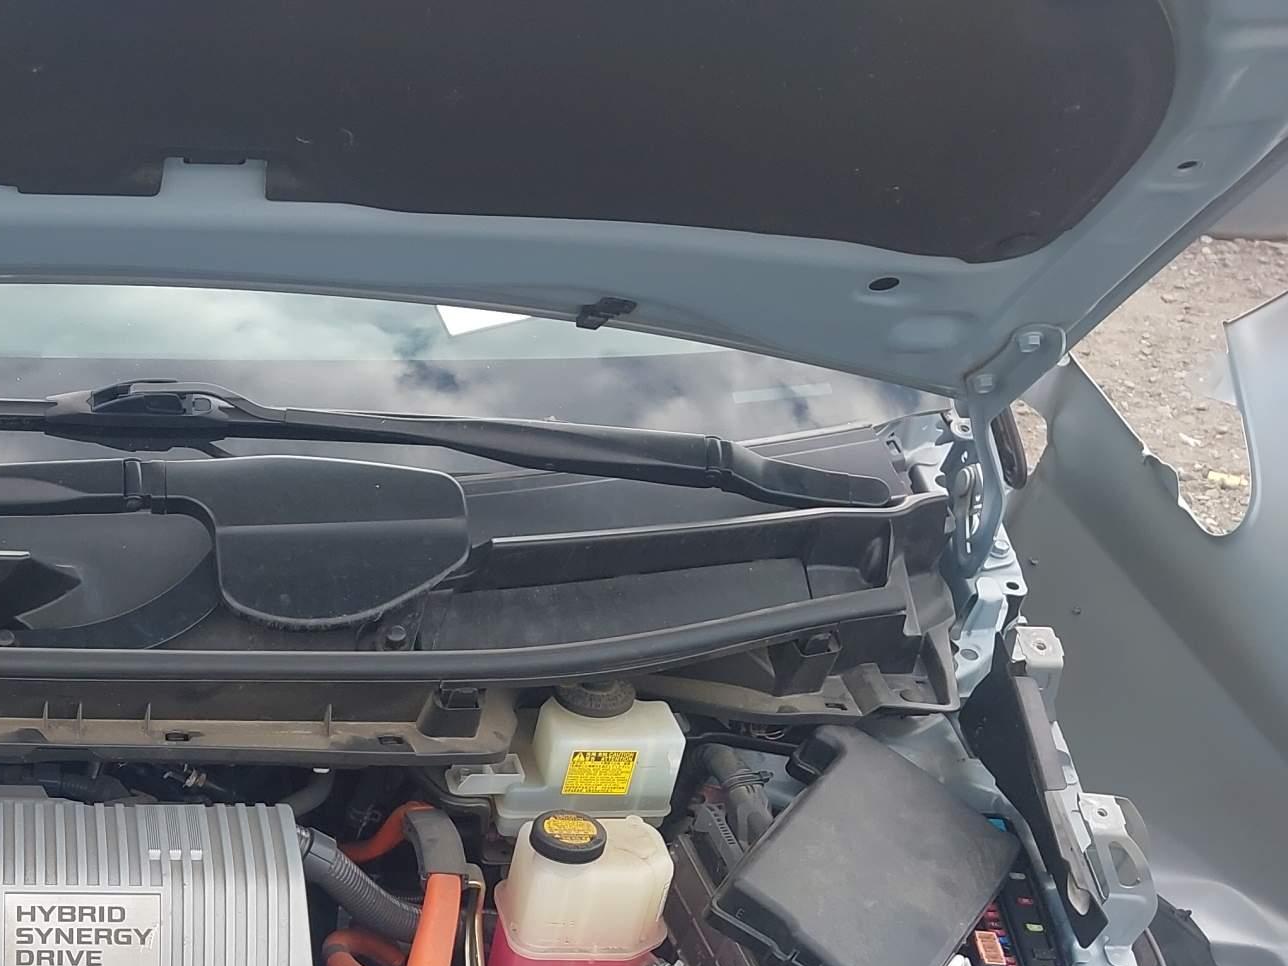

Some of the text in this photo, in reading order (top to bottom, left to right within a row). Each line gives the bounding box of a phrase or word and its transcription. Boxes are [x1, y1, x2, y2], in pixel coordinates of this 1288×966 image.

[16, 905, 126, 923] HYBRID
[15, 927, 153, 945] SYNERGY
[15, 949, 103, 966] DRIVE
